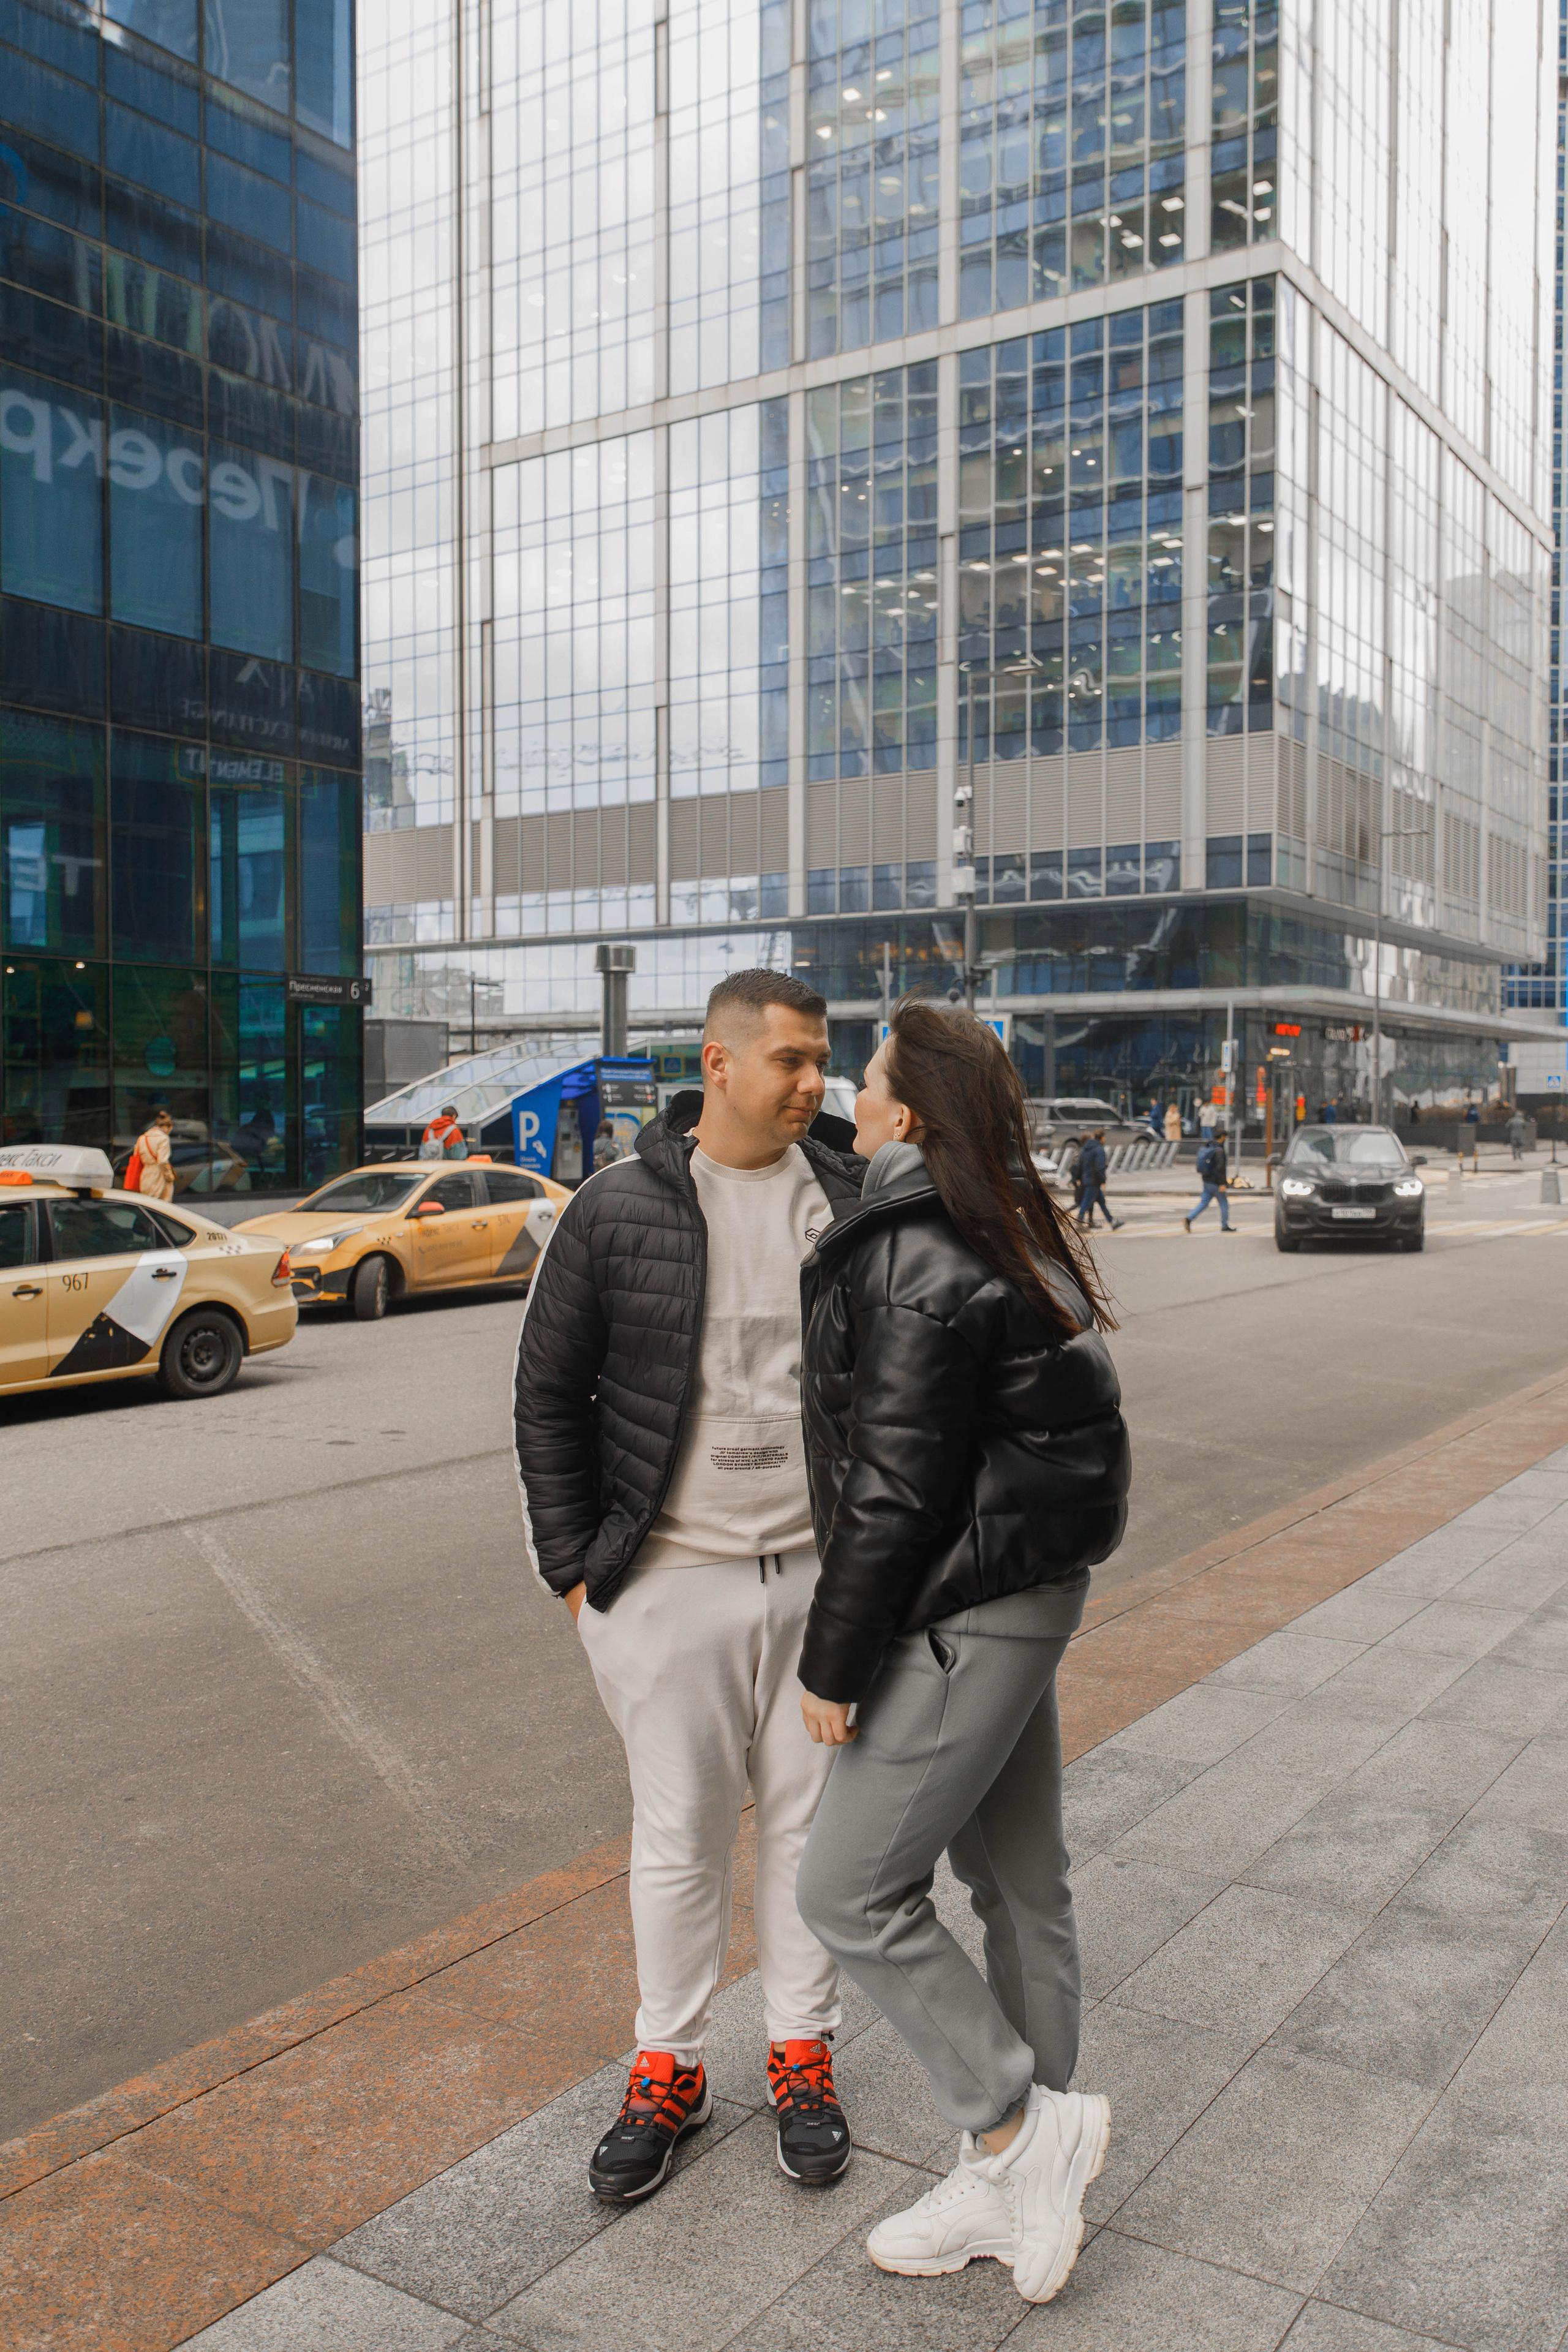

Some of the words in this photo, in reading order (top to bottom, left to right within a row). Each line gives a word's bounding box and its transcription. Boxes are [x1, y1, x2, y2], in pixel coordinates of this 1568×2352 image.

[289, 980, 343, 994] Пресненская
[350, 981, 360, 1000] 6
[519, 1110, 540, 1152] P
[20, 1148, 62, 1167] Такси
[62, 1272, 89, 1293] 967
